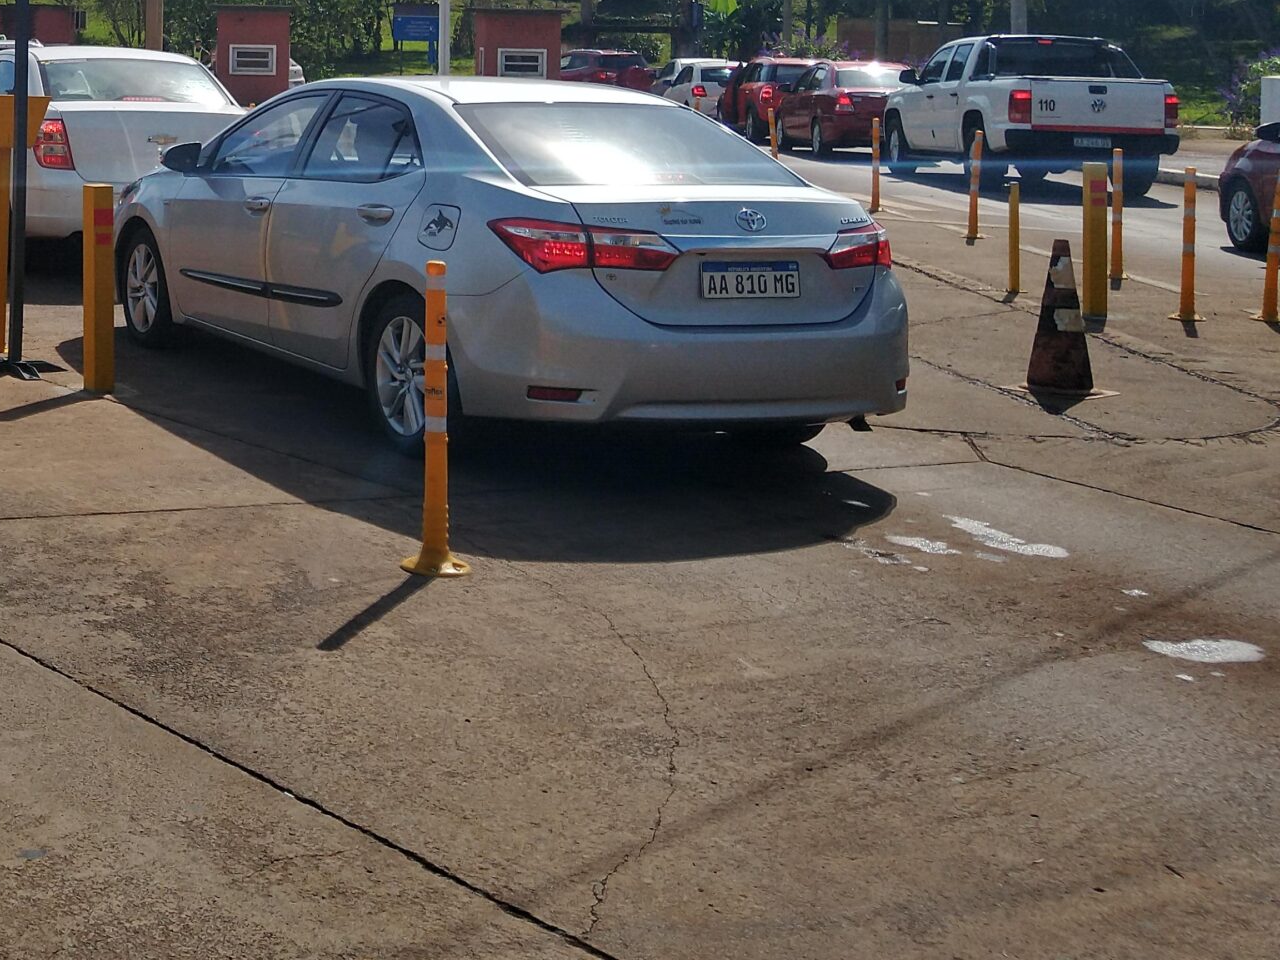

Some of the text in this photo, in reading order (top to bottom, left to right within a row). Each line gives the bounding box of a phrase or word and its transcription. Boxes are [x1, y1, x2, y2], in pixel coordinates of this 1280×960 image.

[1038, 98, 1056, 112] 110
[708, 273, 795, 295] AA 810 MG
